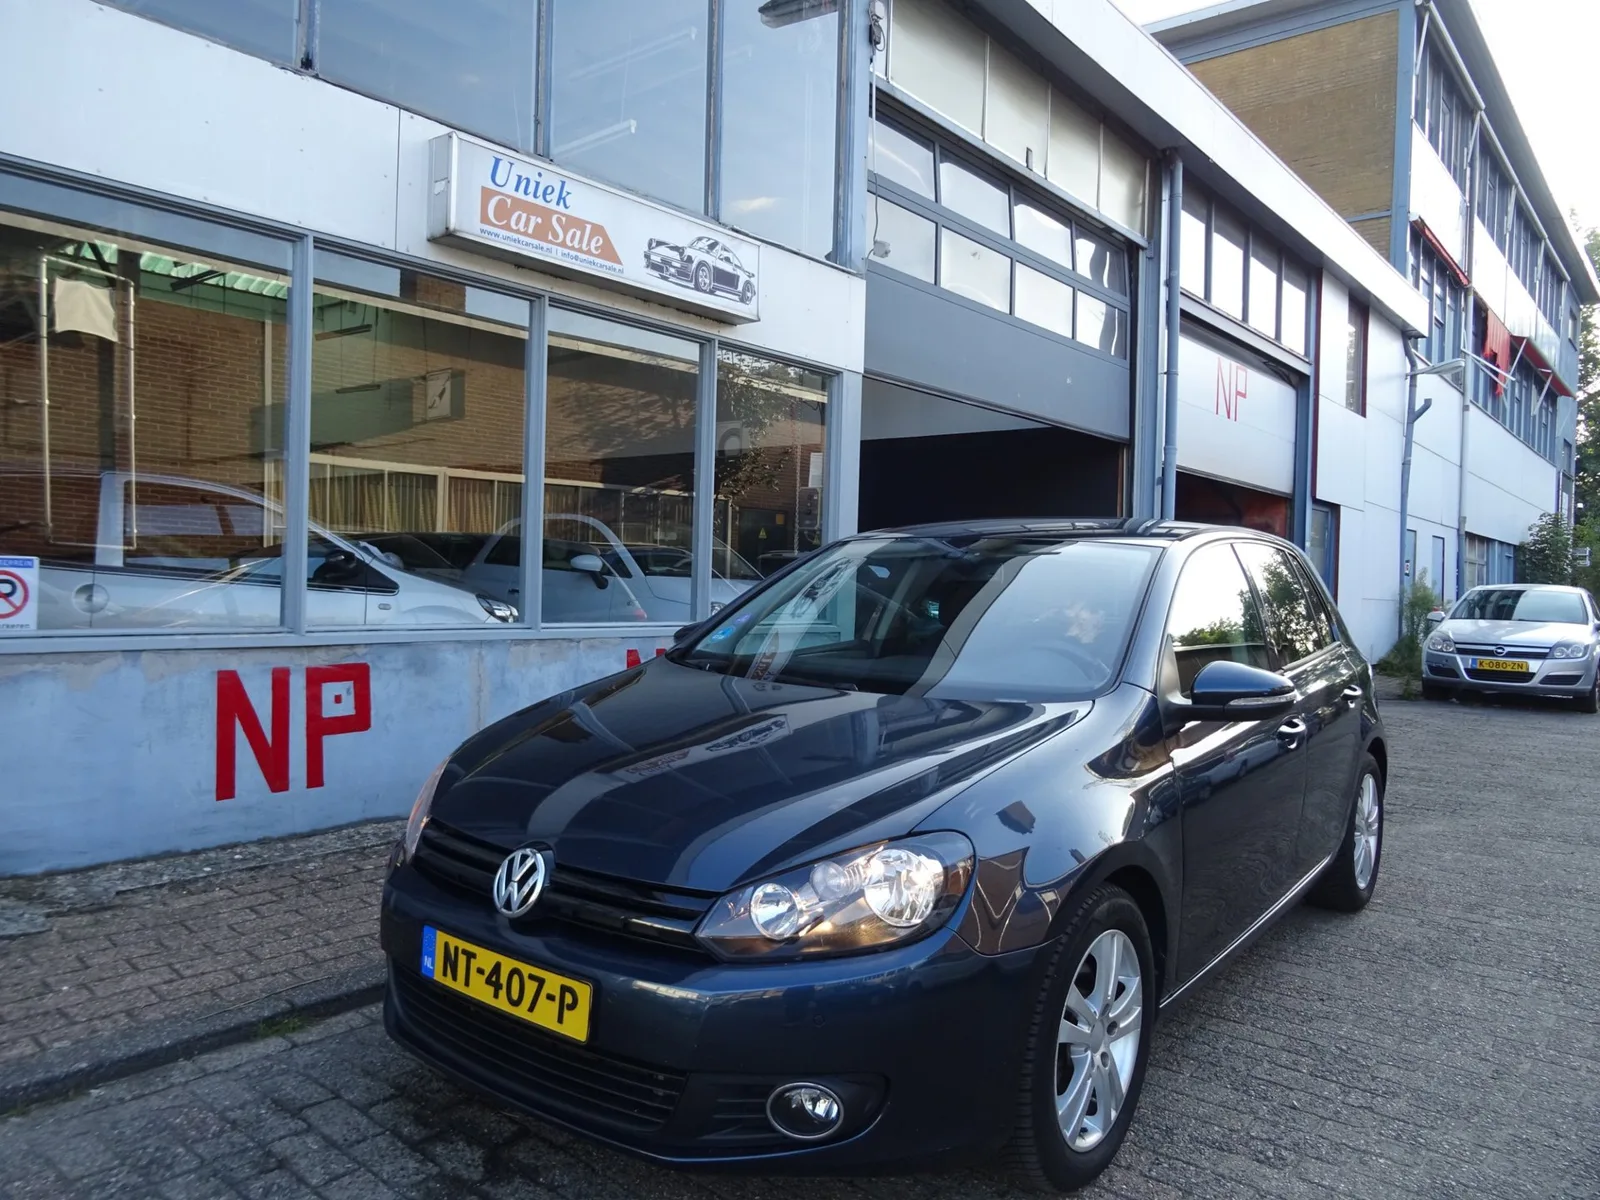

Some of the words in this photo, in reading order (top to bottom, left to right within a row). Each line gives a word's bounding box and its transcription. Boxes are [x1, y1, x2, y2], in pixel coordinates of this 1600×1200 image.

[490, 156, 572, 209] Uniek
[480, 228, 553, 254] www.uniekcarsale.nl
[560, 251, 624, 274] info@uniekcarsale.nl
[487, 195, 542, 235] Car
[548, 213, 603, 255] Sale
[1215, 357, 1247, 422] NP
[1479, 661, 1524, 670] K-080-ZN
[216, 662, 371, 801] NP
[424, 955, 434, 970] NL
[442, 940, 579, 1025] NT-407-P
